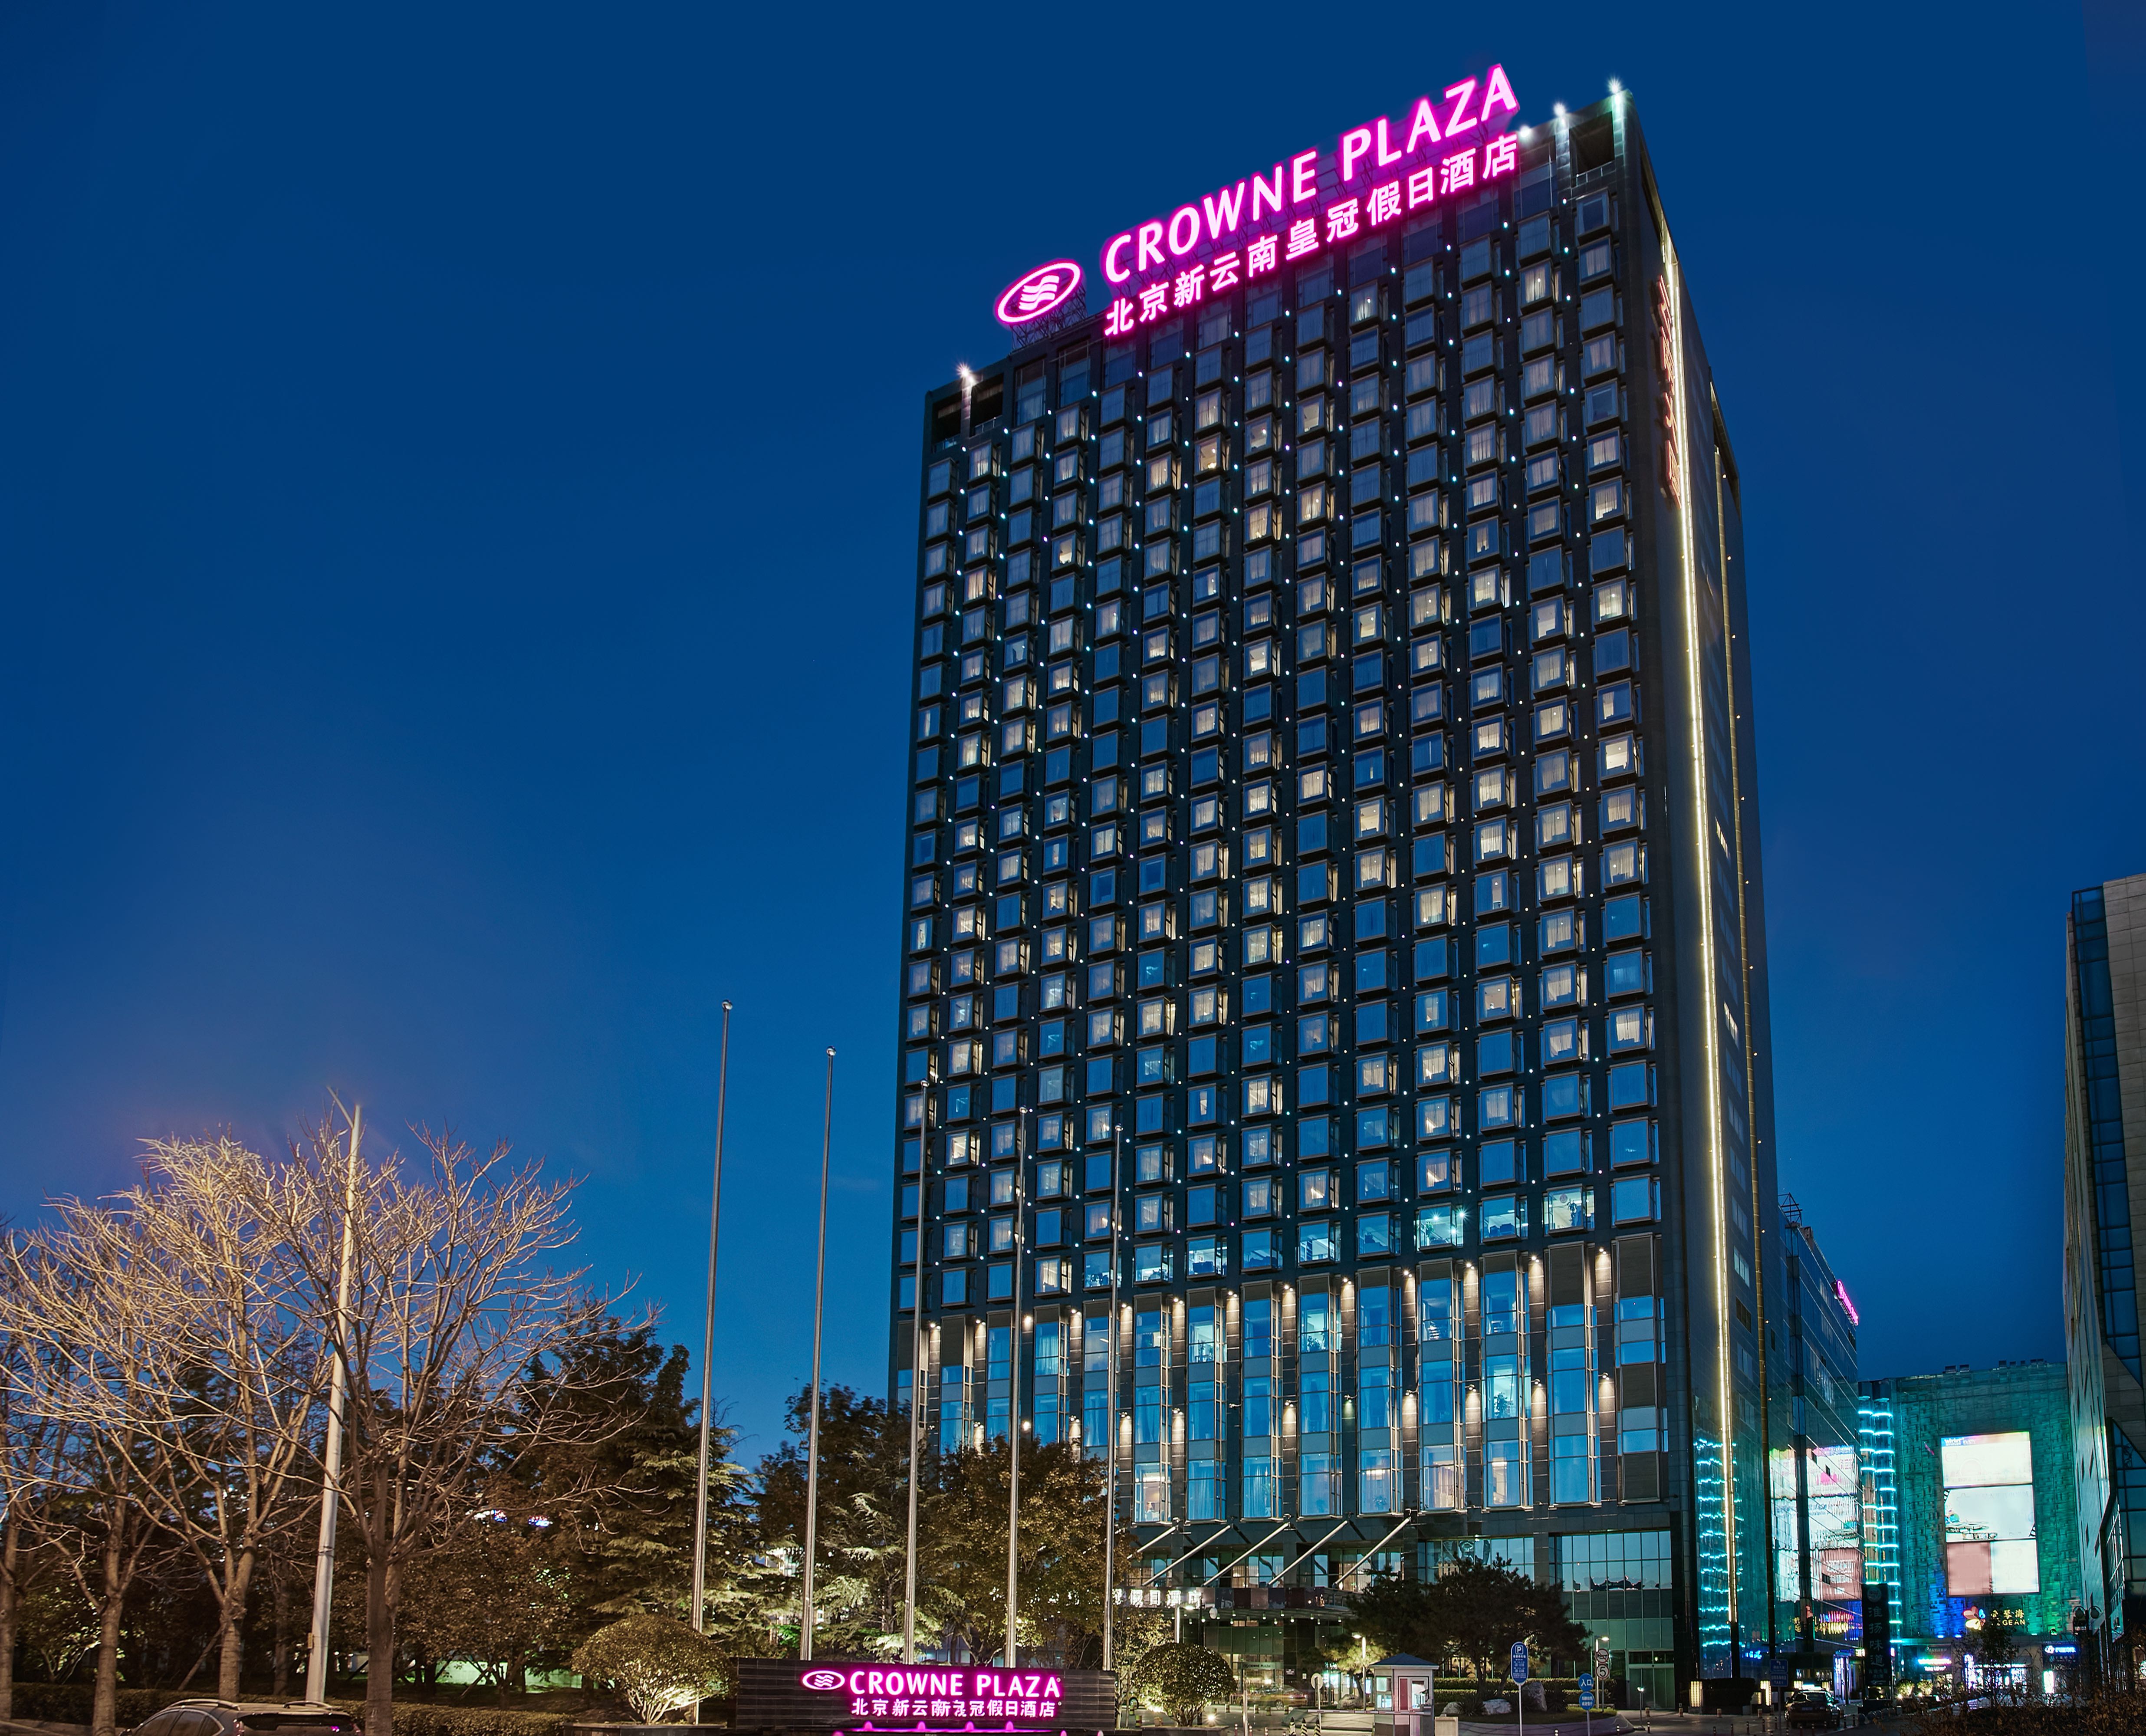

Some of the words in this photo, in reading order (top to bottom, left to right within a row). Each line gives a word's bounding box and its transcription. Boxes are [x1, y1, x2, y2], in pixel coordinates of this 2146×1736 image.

[1104, 150, 1318, 283] CROWNE
[1342, 66, 1518, 181] PLAZA
[1103, 133, 1519, 337] 北京新云南皇冠假日酒店
[1867, 1605, 1885, 1667] 淮扬味道
[849, 1670, 963, 1696] CROWNE
[976, 1674, 1060, 1698] PLAZA
[1581, 1679, 1592, 1687] 入口
[1600, 1667, 1606, 1677] 5
